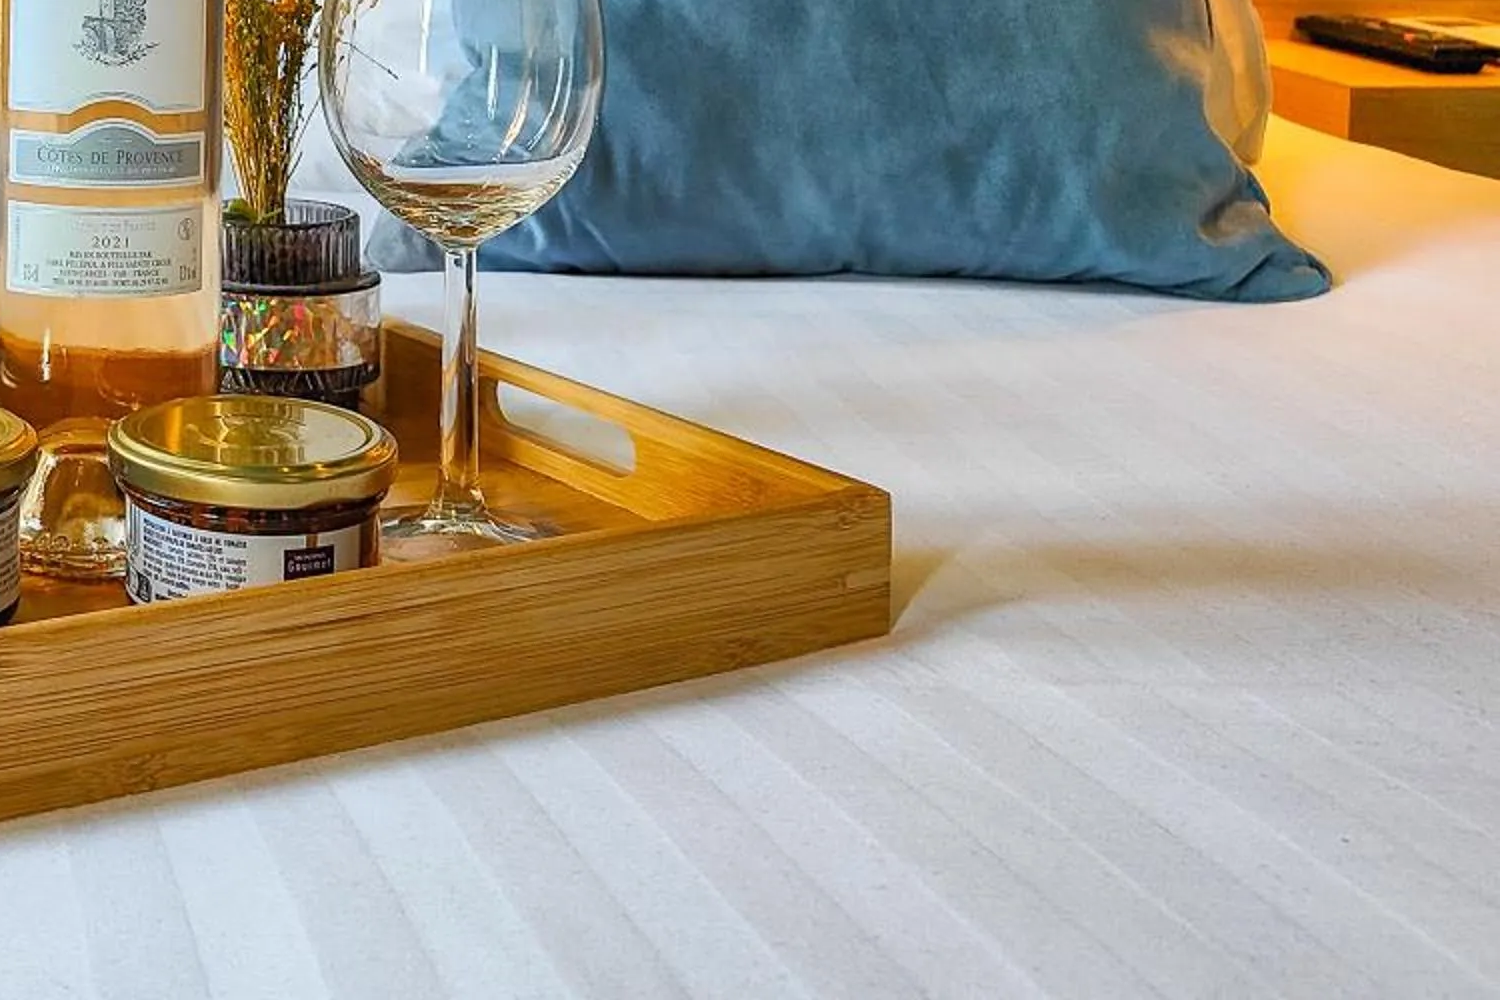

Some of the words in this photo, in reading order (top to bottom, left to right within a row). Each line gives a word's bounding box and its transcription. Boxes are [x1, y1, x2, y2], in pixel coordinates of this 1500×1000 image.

[91, 150, 109, 165] DE
[115, 149, 184, 166] PROVENCE
[91, 235, 130, 249] 2021
